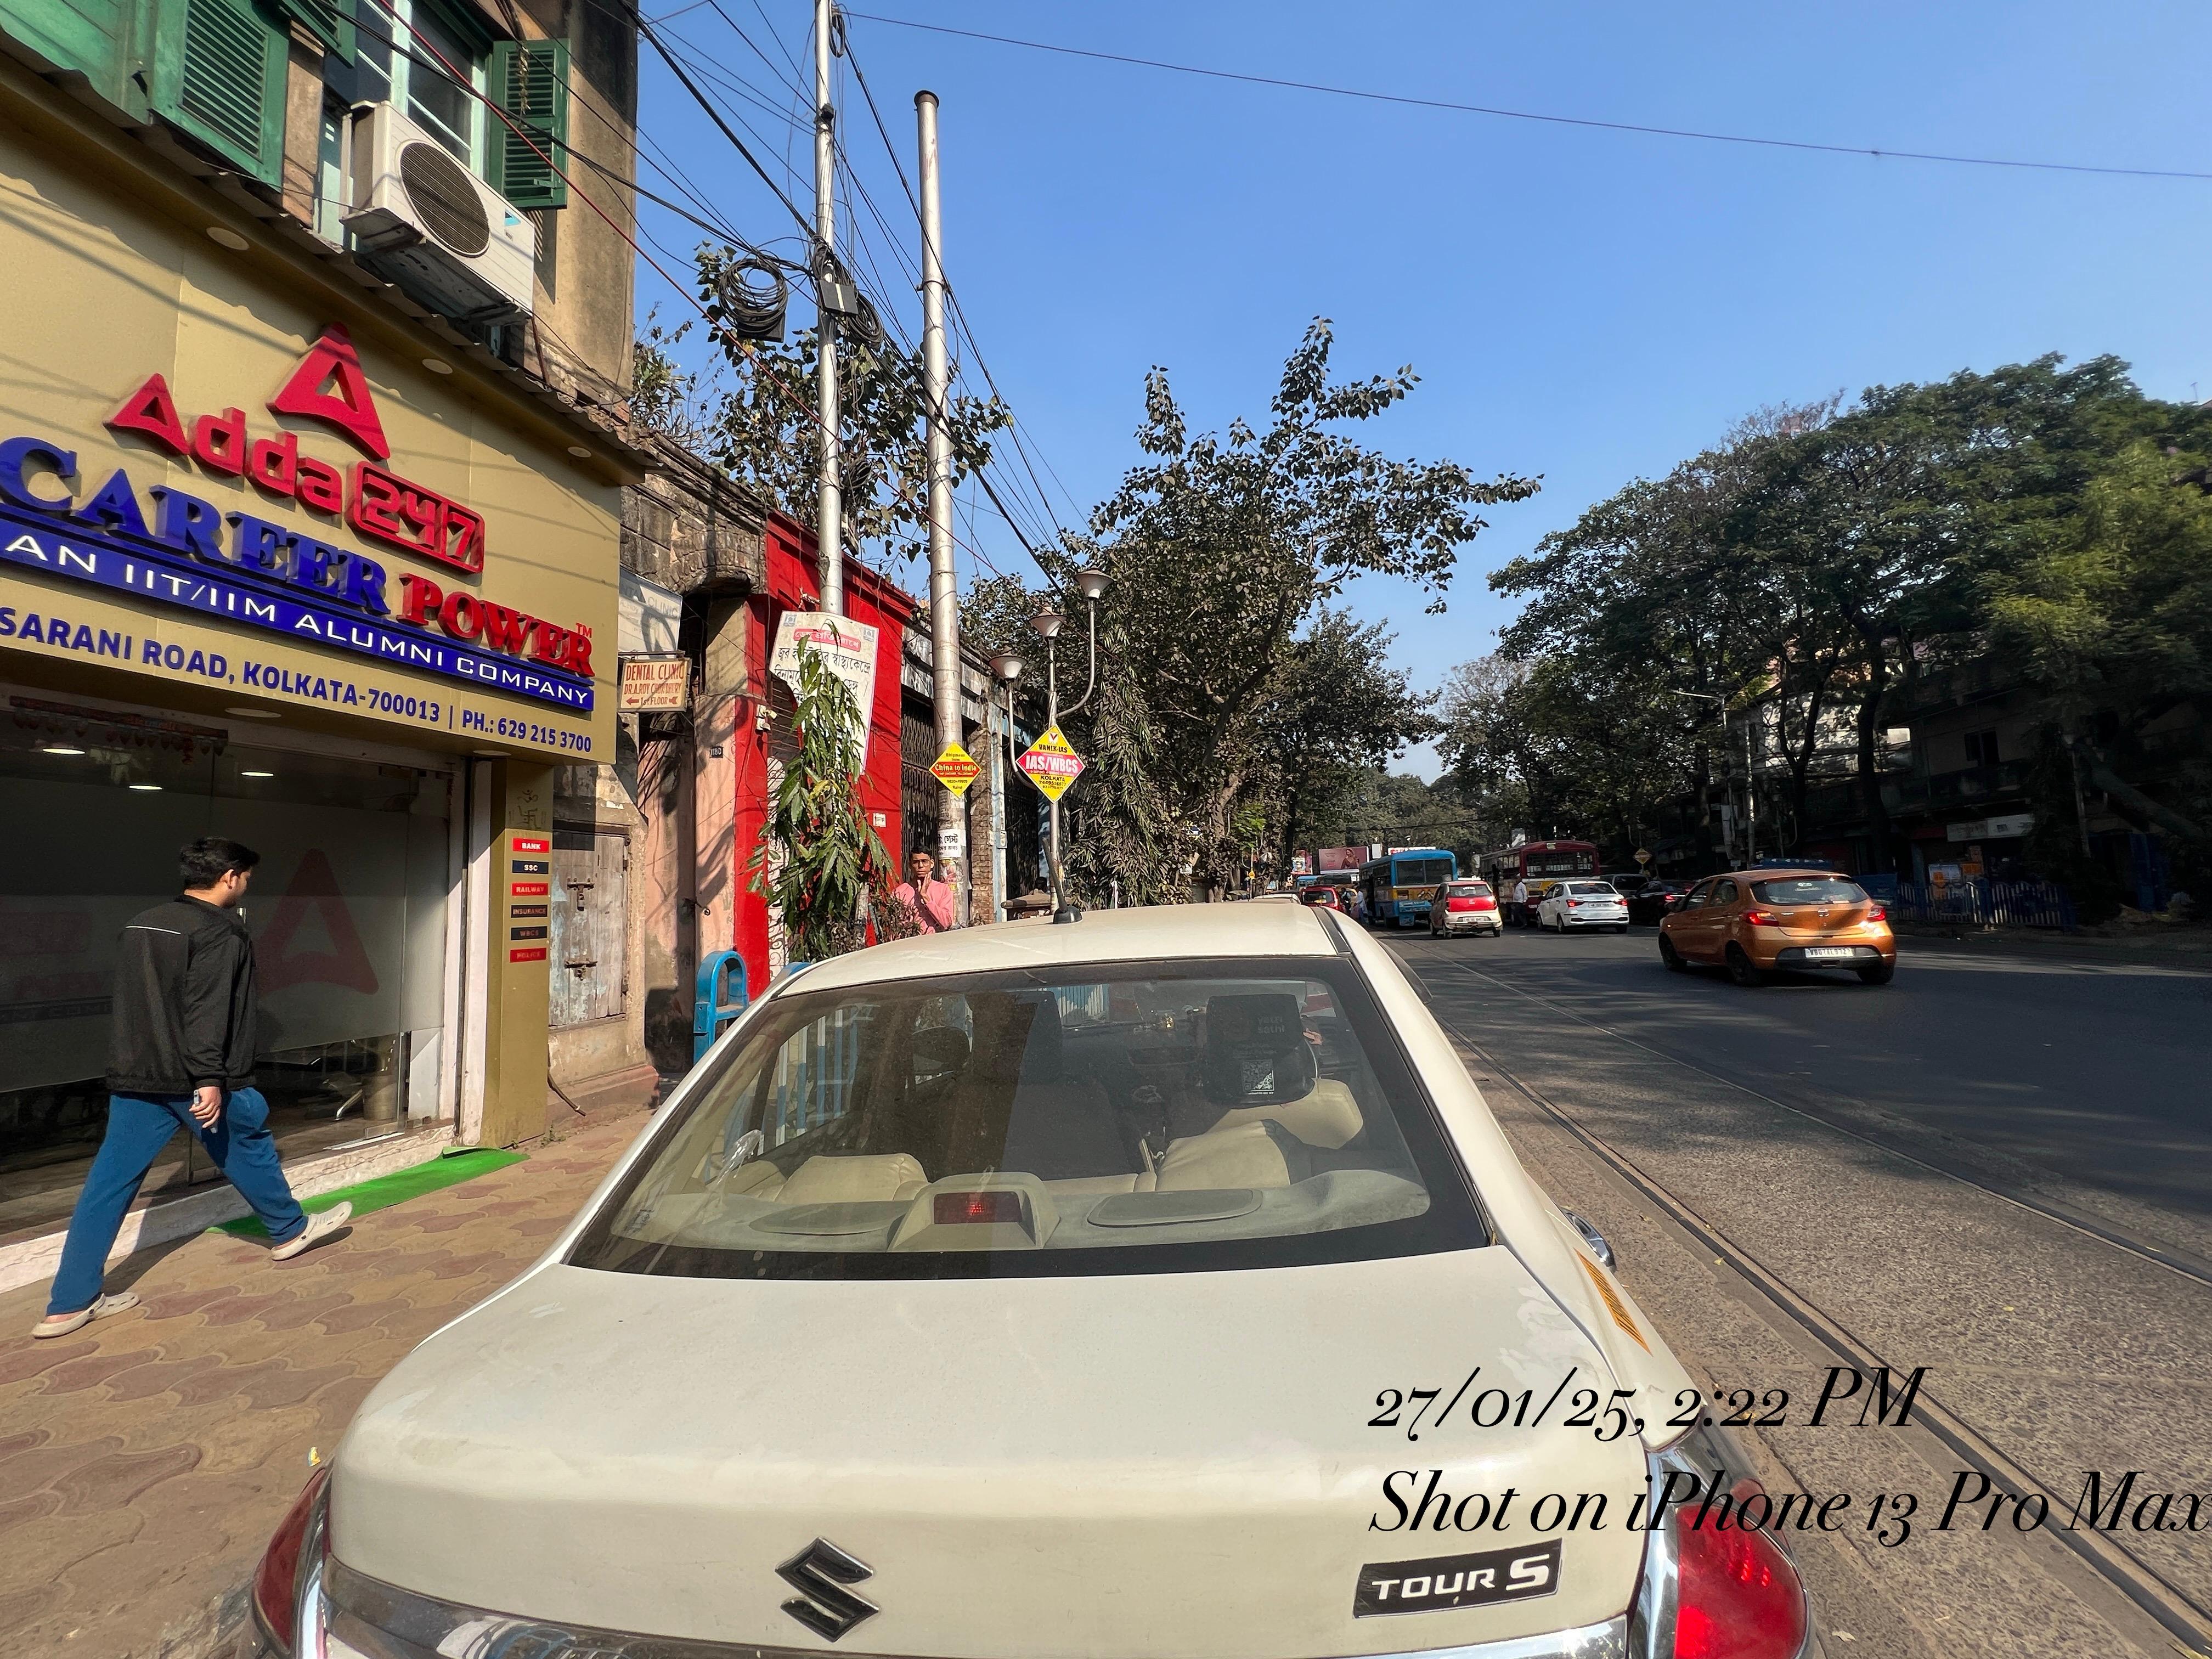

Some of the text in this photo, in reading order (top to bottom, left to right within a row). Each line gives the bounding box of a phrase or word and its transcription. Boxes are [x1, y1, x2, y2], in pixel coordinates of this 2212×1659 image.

[103, 373, 342, 514] Adda
[0, 437, 595, 677] CAREER POWER
[6, 535, 588, 704] AN IIT/IIM ALUMNI COMPANY
[575, 622, 592, 638] TM
[0, 607, 132, 659] SARANI
[142, 639, 235, 684] ROAD,
[244, 662, 439, 722] KOLKATA-700013
[498, 717, 527, 740] 629
[531, 724, 556, 746] 215
[560, 731, 591, 752] 3700
[625, 663, 684, 681] DENTAL CLINIC
[650, 697, 668, 705] FLOOR
[1025, 755, 1078, 774] IAS/WBCS
[1039, 744, 1068, 753] VANIK-IAS
[1372, 1554, 1550, 1600] TOUR S
